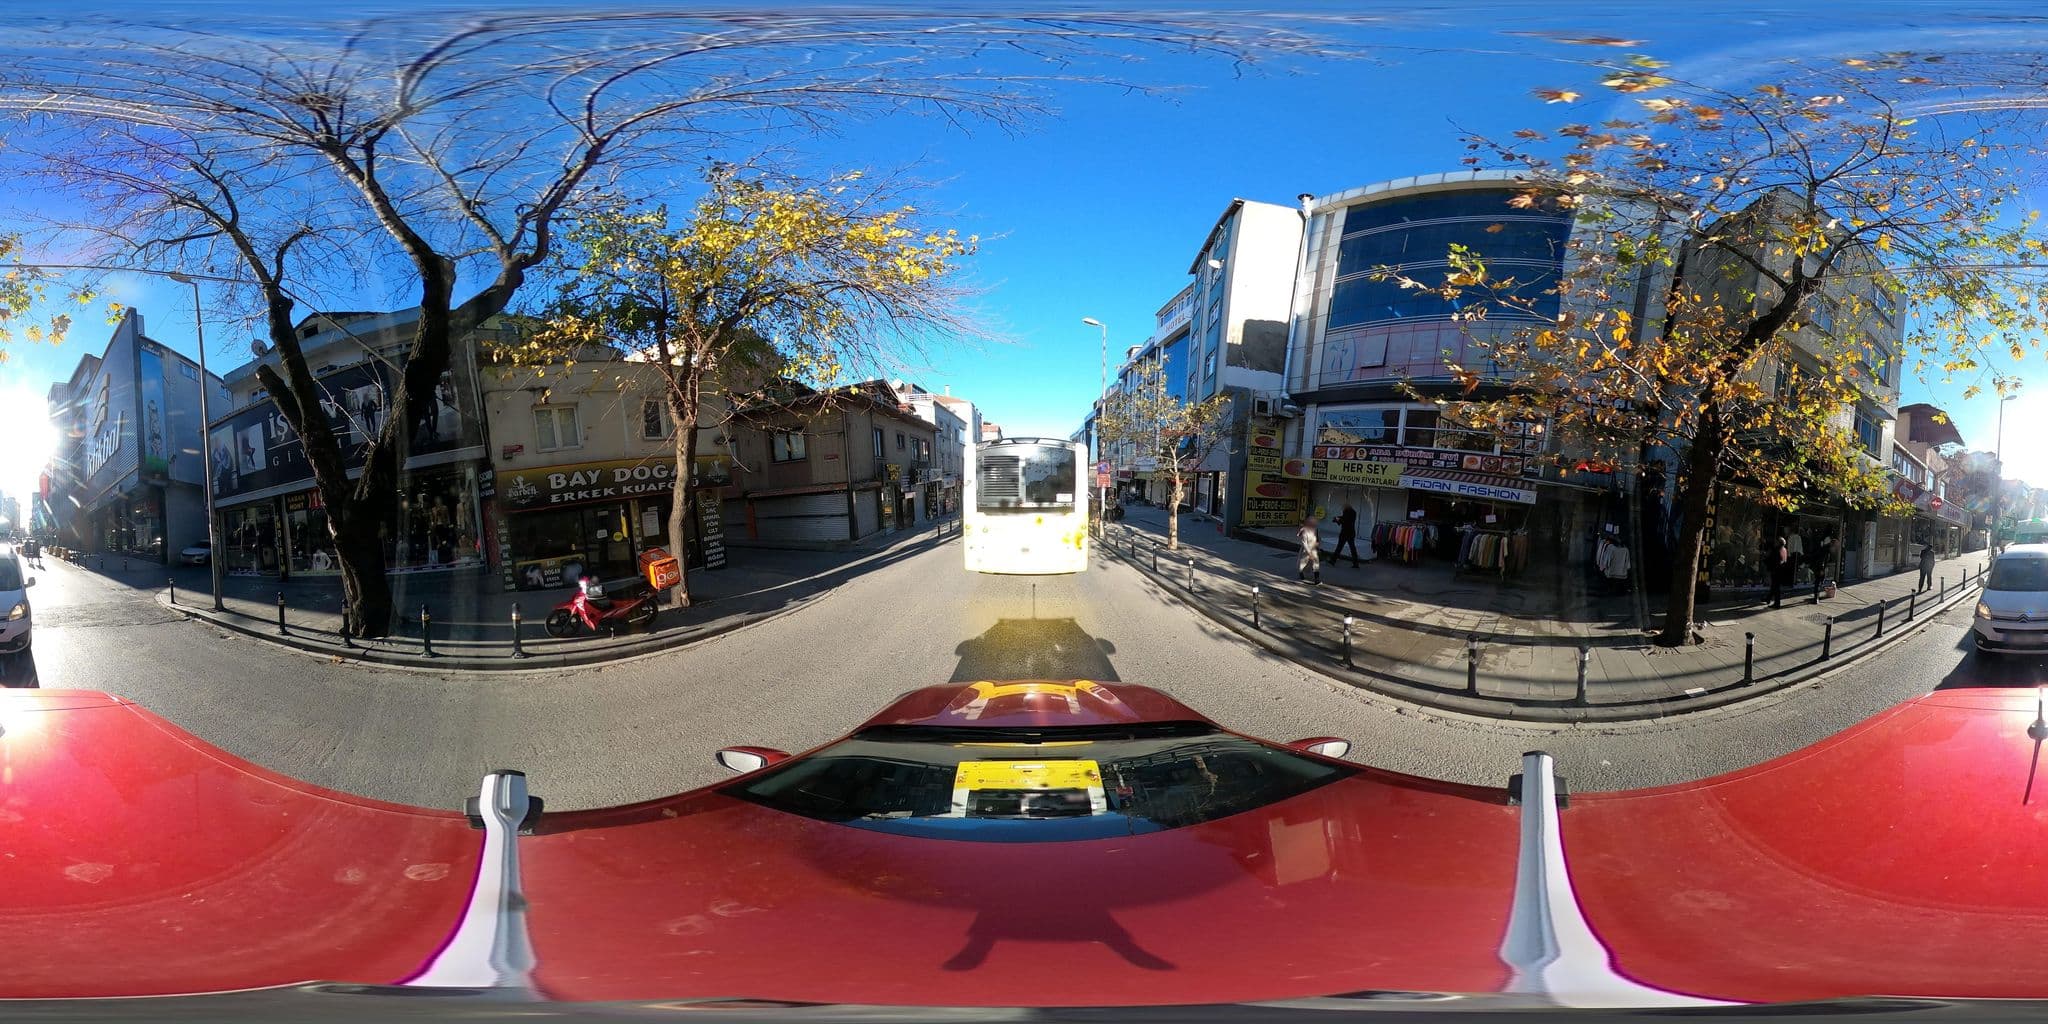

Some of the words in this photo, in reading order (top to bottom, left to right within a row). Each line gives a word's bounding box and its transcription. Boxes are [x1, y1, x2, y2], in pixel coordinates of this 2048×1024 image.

[1343, 463, 1364, 473] HER
[547, 469, 602, 490] BAY
[1339, 475, 1360, 483] UYGUN
[550, 487, 617, 503] ERKEK
[1457, 484, 1521, 500] FASHION
[1255, 511, 1271, 520] HER
